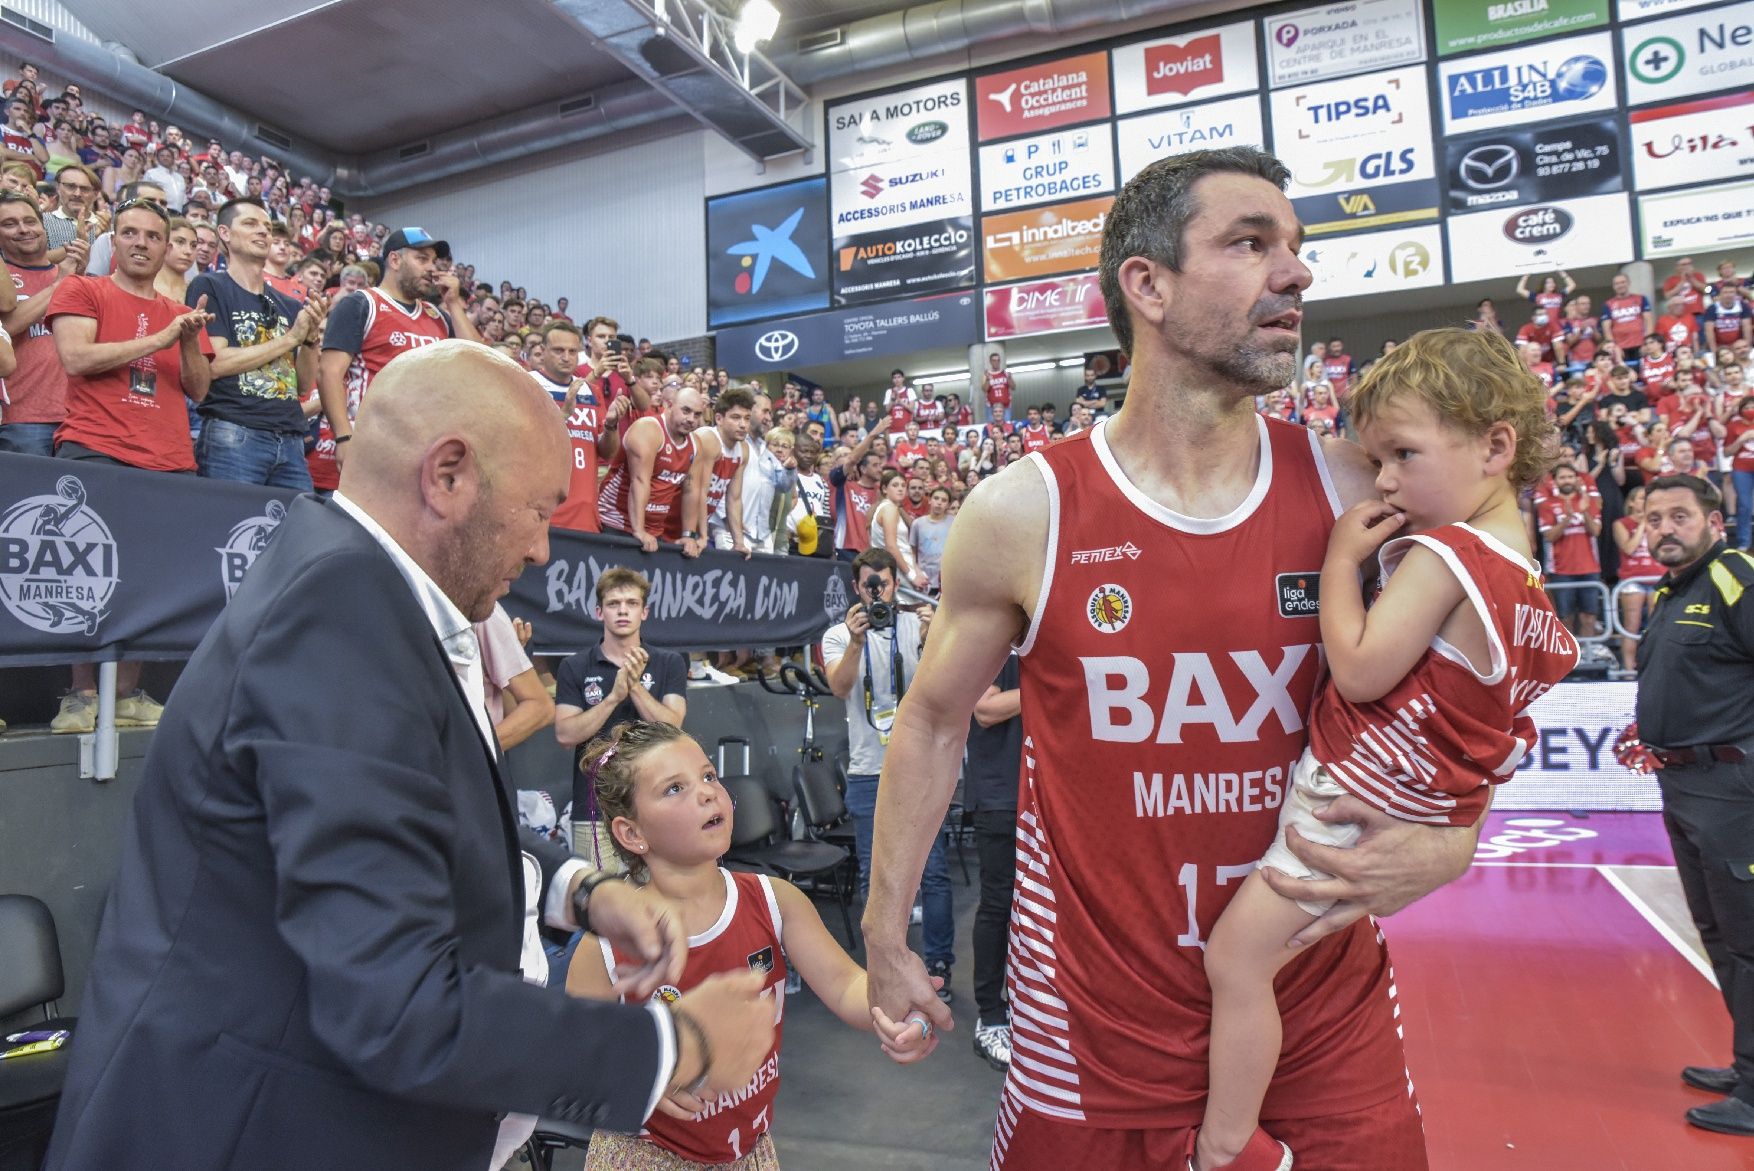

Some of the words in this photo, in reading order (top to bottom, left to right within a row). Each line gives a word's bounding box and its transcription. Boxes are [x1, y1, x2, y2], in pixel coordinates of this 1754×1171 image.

[1350, 36, 1413, 56] MANRESA
[1153, 53, 1213, 78] Joviat
[1020, 71, 1088, 95] Catalana
[1509, 81, 1551, 102] S4B
[885, 92, 961, 120] MOTORS
[1021, 84, 1088, 110] Occident
[1023, 99, 1088, 119] Assegurances
[1307, 94, 1391, 124] TIPSA
[1148, 123, 1233, 149] VITAM
[1022, 161, 1068, 181] GRUP
[1359, 147, 1415, 180] GLS
[889, 168, 945, 188] SUZUKI
[993, 173, 1102, 204] PETROBAGES
[837, 201, 907, 224] ACCESSORIS
[909, 192, 964, 211] MANRESA
[1517, 209, 1556, 228] café
[1514, 222, 1561, 239] crem
[840, 282, 874, 294] ACCESSORIS
[874, 279, 900, 290] MANRESA
[844, 321, 874, 332] TOYOTA
[876, 314, 908, 327] TALLERS
[910, 310, 940, 324] BALLÚS
[568, 429, 595, 442] ANRESA
[575, 447, 586, 469] 8
[0, 537, 113, 578] BAXI
[1071, 545, 1124, 565] PENTEX
[19, 584, 96, 602] MANRESA
[546, 555, 798, 623] BAXANRESA.COM
[1284, 586, 1305, 600] liga
[1285, 598, 1320, 611] endes
[1517, 727, 1622, 772] EY
